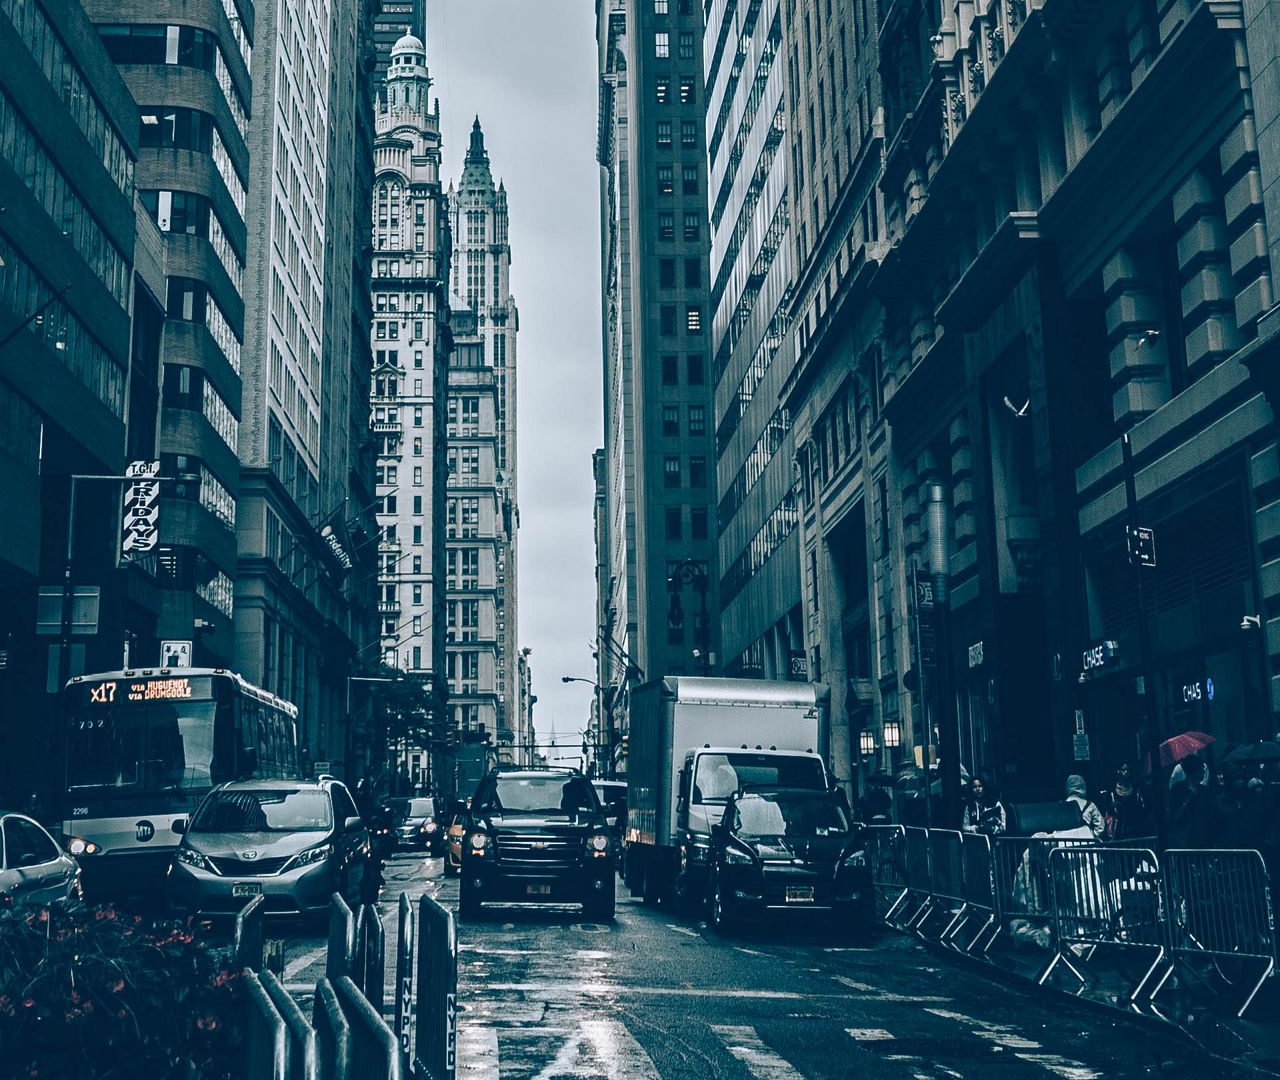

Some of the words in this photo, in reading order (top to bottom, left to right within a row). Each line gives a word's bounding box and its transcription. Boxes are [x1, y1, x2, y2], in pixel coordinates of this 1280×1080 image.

[131, 464, 155, 474] T.G.I.
[322, 534, 353, 570] Fidelity
[1082, 645, 1105, 671] CHASE
[90, 682, 117, 702] x17
[147, 679, 189, 691] HUGUENOT
[402, 979, 412, 1054] NYPD
[448, 995, 456, 1068] NYPD
